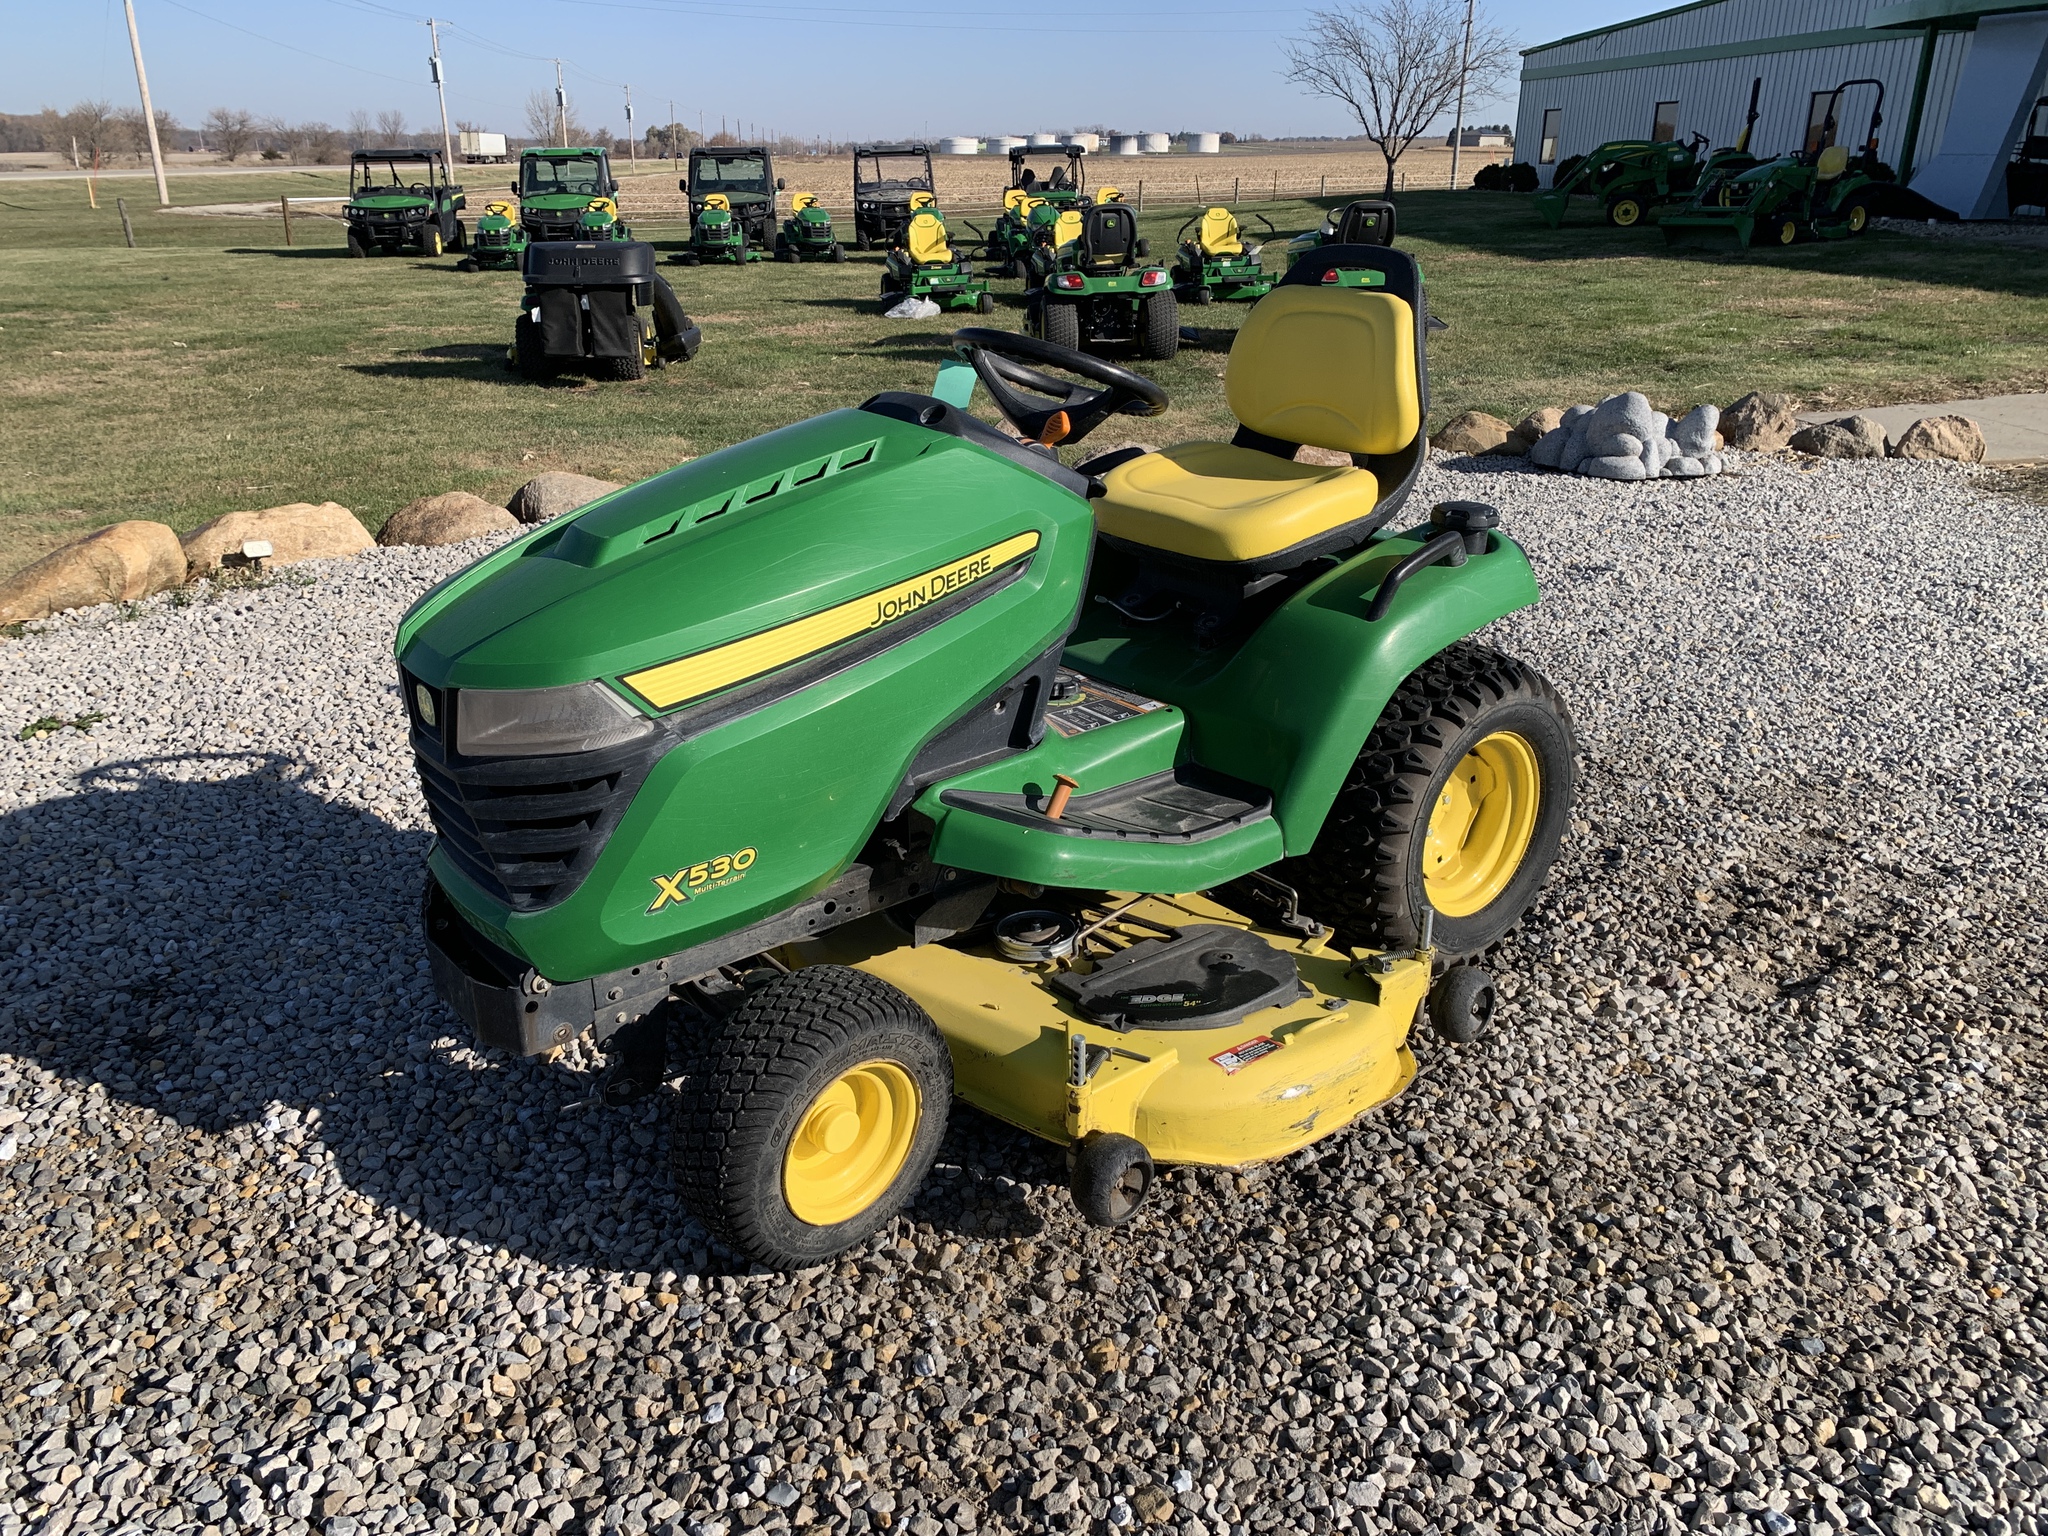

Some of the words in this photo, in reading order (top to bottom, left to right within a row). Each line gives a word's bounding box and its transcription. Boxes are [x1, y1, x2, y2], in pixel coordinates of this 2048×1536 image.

[548, 257, 579, 266] JOHN
[581, 257, 620, 266] DEERE
[870, 585, 926, 625] JOHN
[930, 554, 992, 597] DEERE
[645, 847, 758, 916] X530
[693, 873, 746, 895] Multi-Terrain
[770, 1053, 841, 1148] GRASS
[847, 1033, 932, 1057] MASTER
